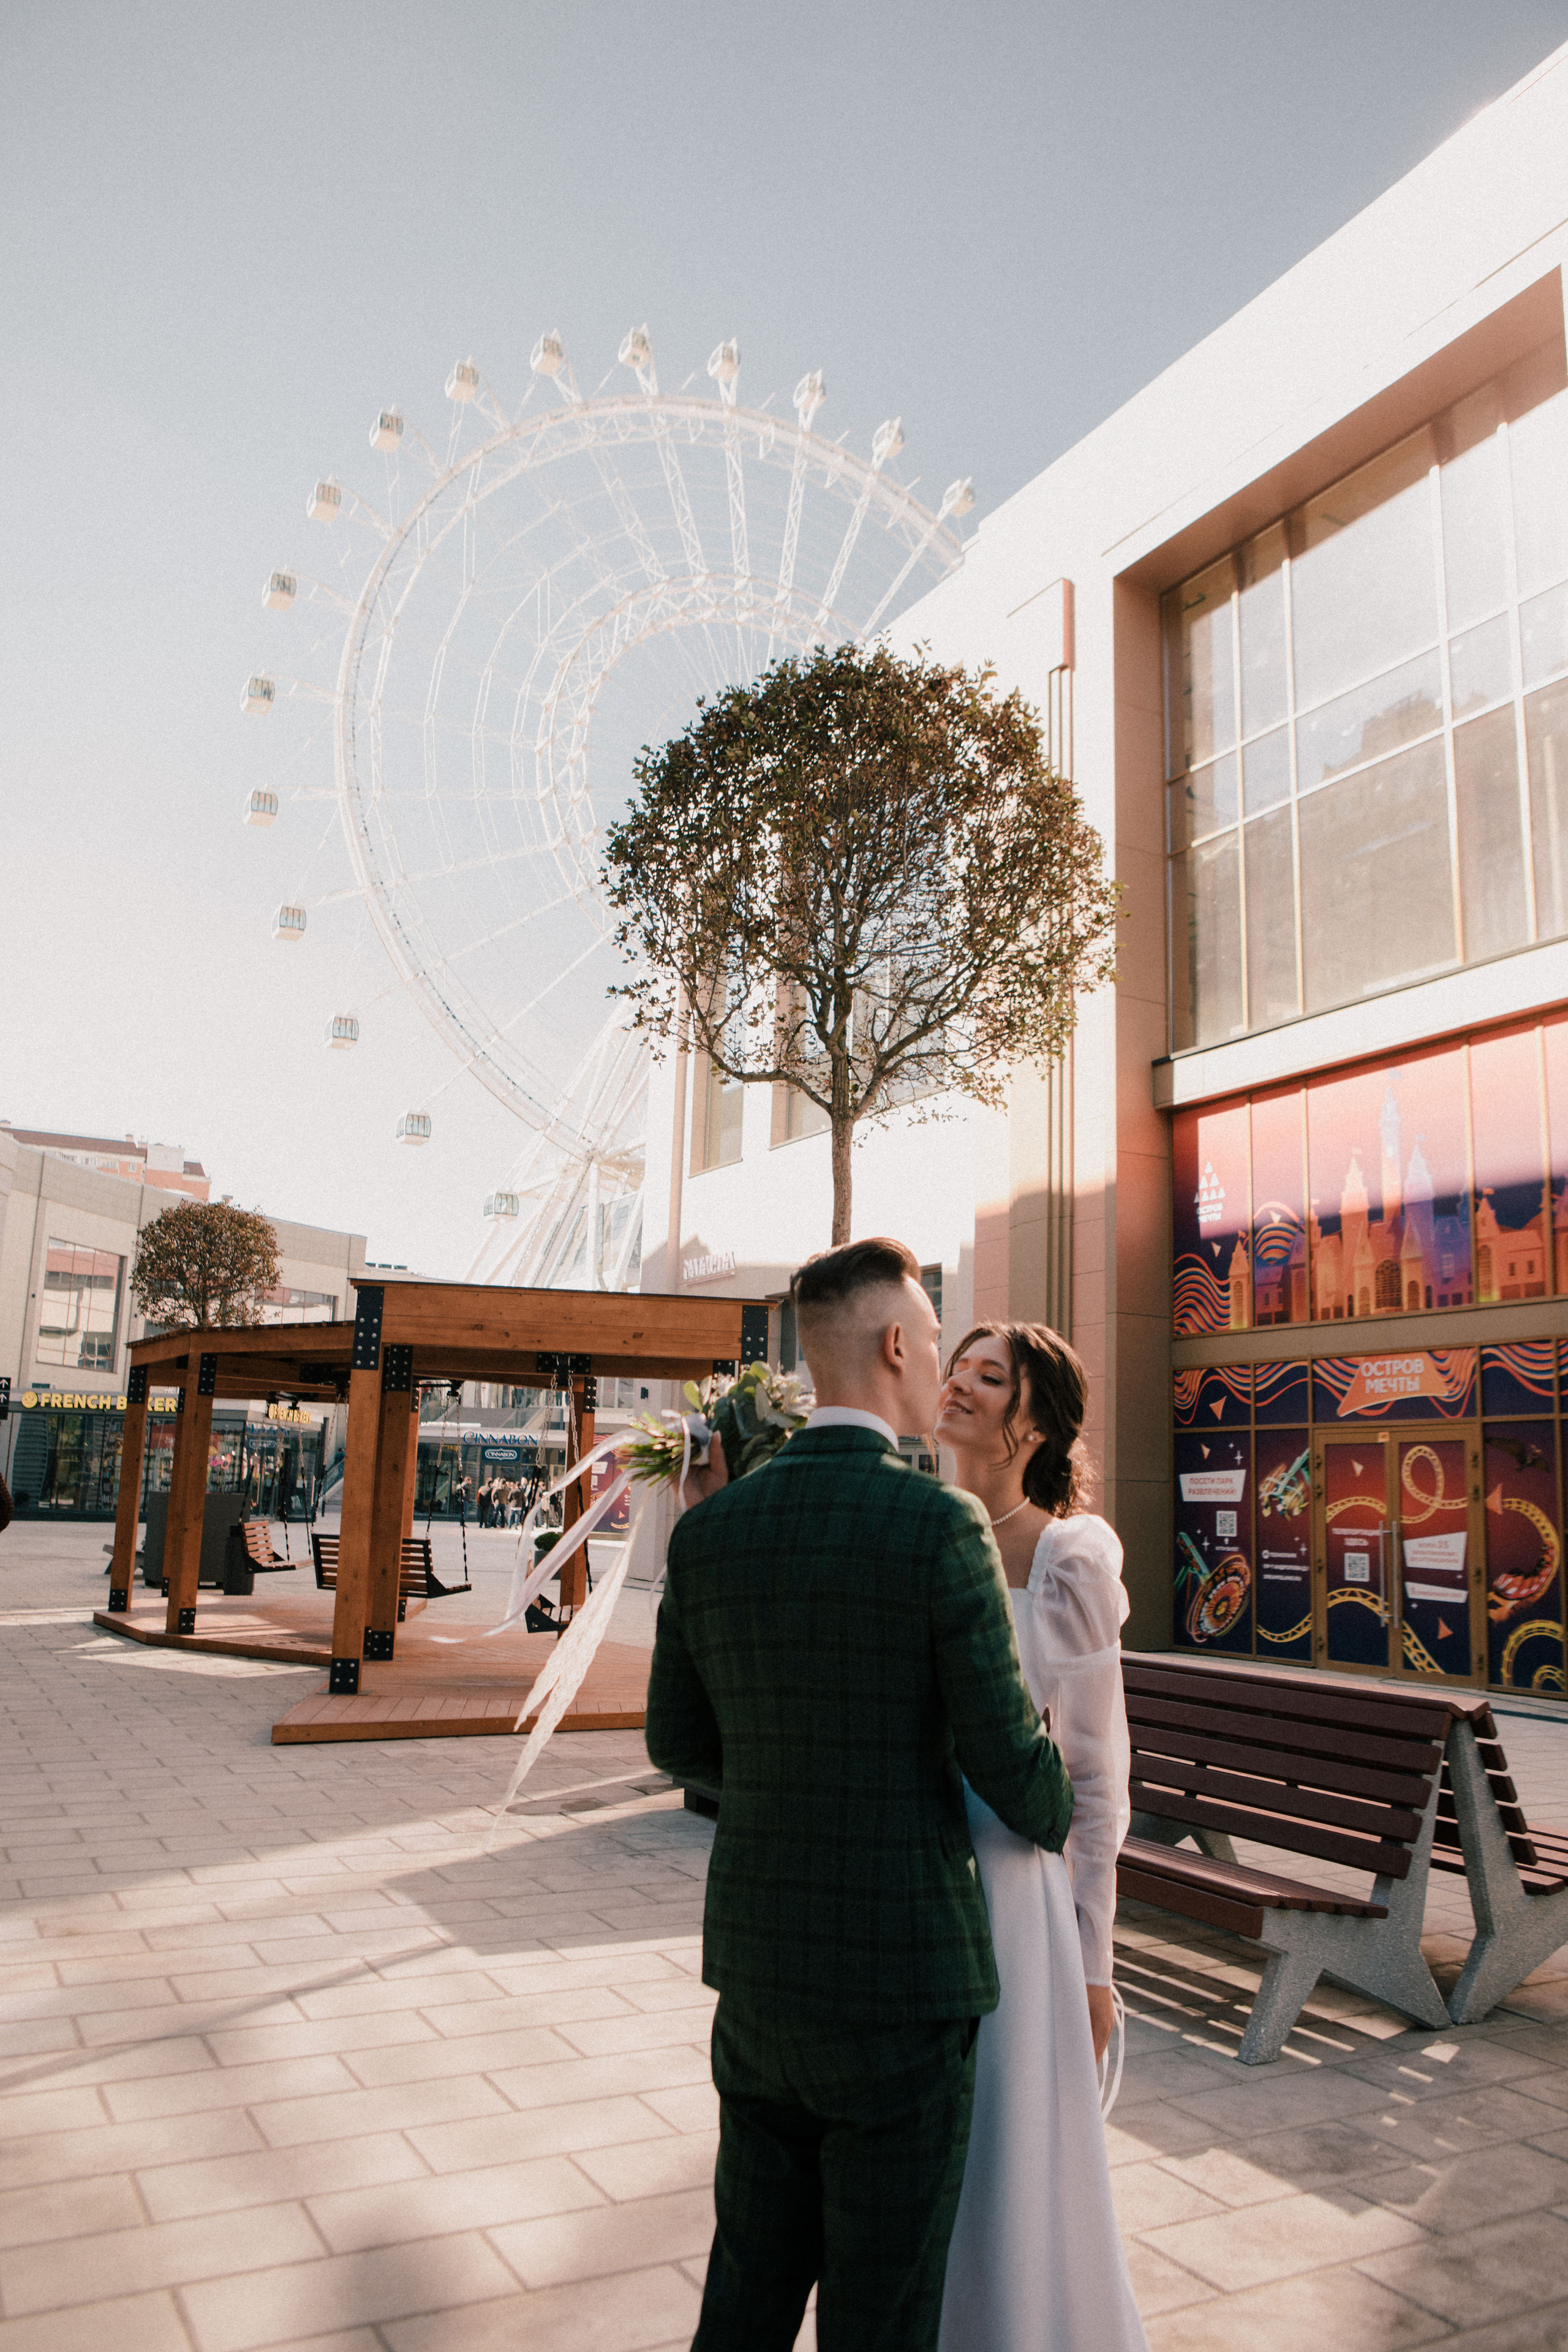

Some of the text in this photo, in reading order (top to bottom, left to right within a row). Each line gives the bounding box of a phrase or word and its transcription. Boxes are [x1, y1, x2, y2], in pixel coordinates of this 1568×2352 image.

[1196, 1203, 1223, 1215] ОСТРОВ
[1361, 1358, 1425, 1377] ОСТРОВ
[1365, 1376, 1420, 1393] МЕЧТЫ
[40, 1392, 177, 1412] FRENCH BKER
[463, 1431, 539, 1446] CINNABON
